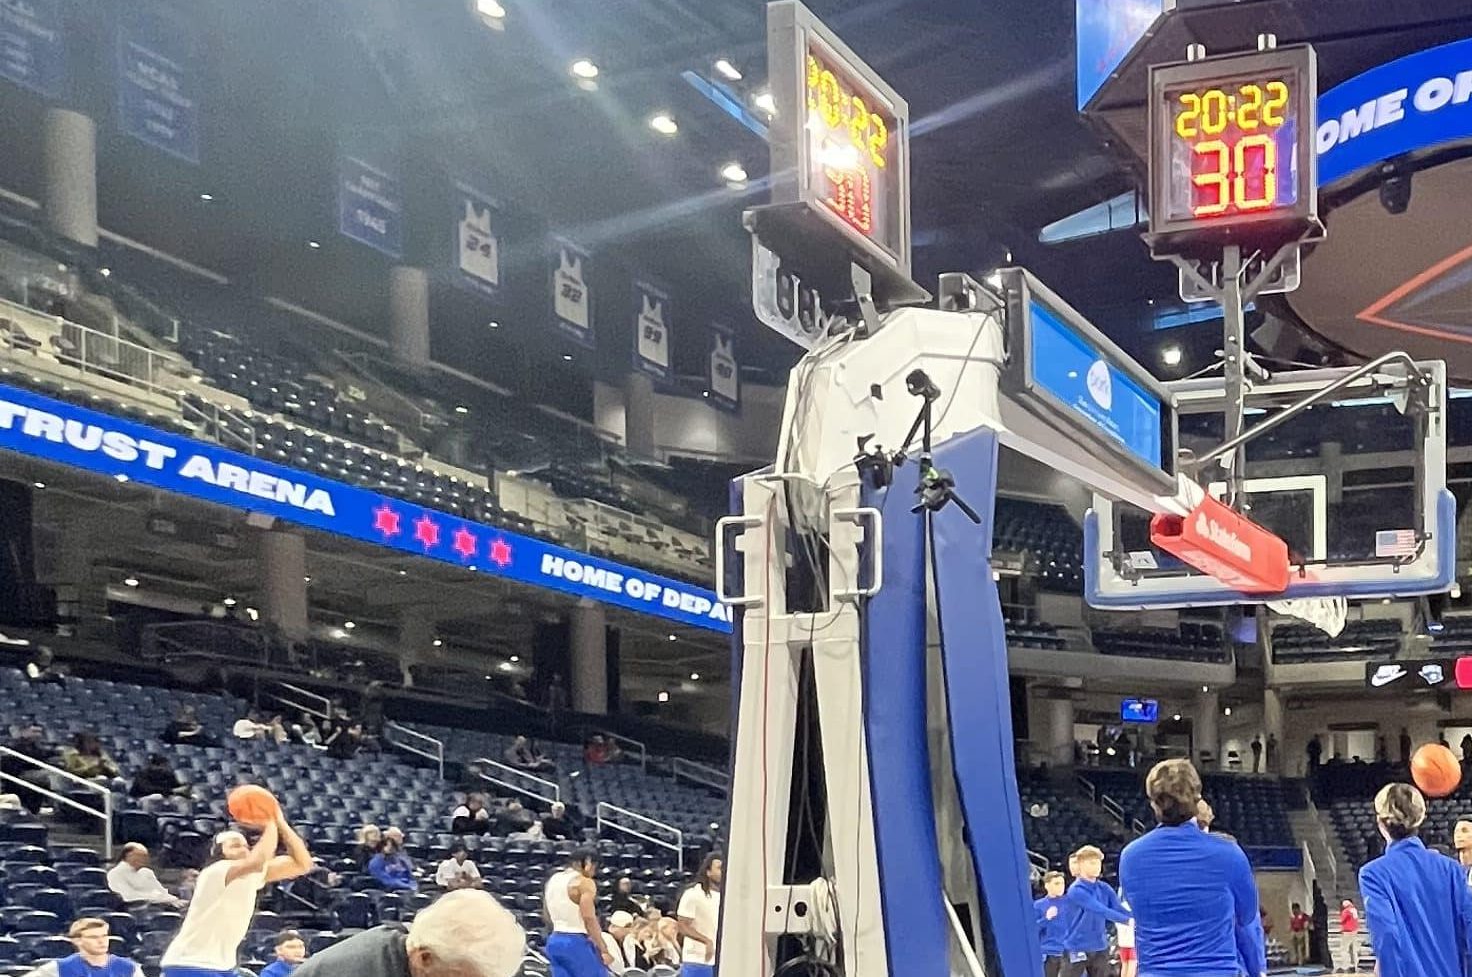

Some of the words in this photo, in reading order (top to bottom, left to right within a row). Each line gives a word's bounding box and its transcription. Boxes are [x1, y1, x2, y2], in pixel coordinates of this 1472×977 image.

[1176, 81, 1289, 138] 20:22
[1194, 134, 1276, 218] 30
[0, 400, 177, 469] TRUST
[179, 455, 336, 517] ARENA
[541, 554, 624, 593] HOME
[625, 578, 662, 602] OF
